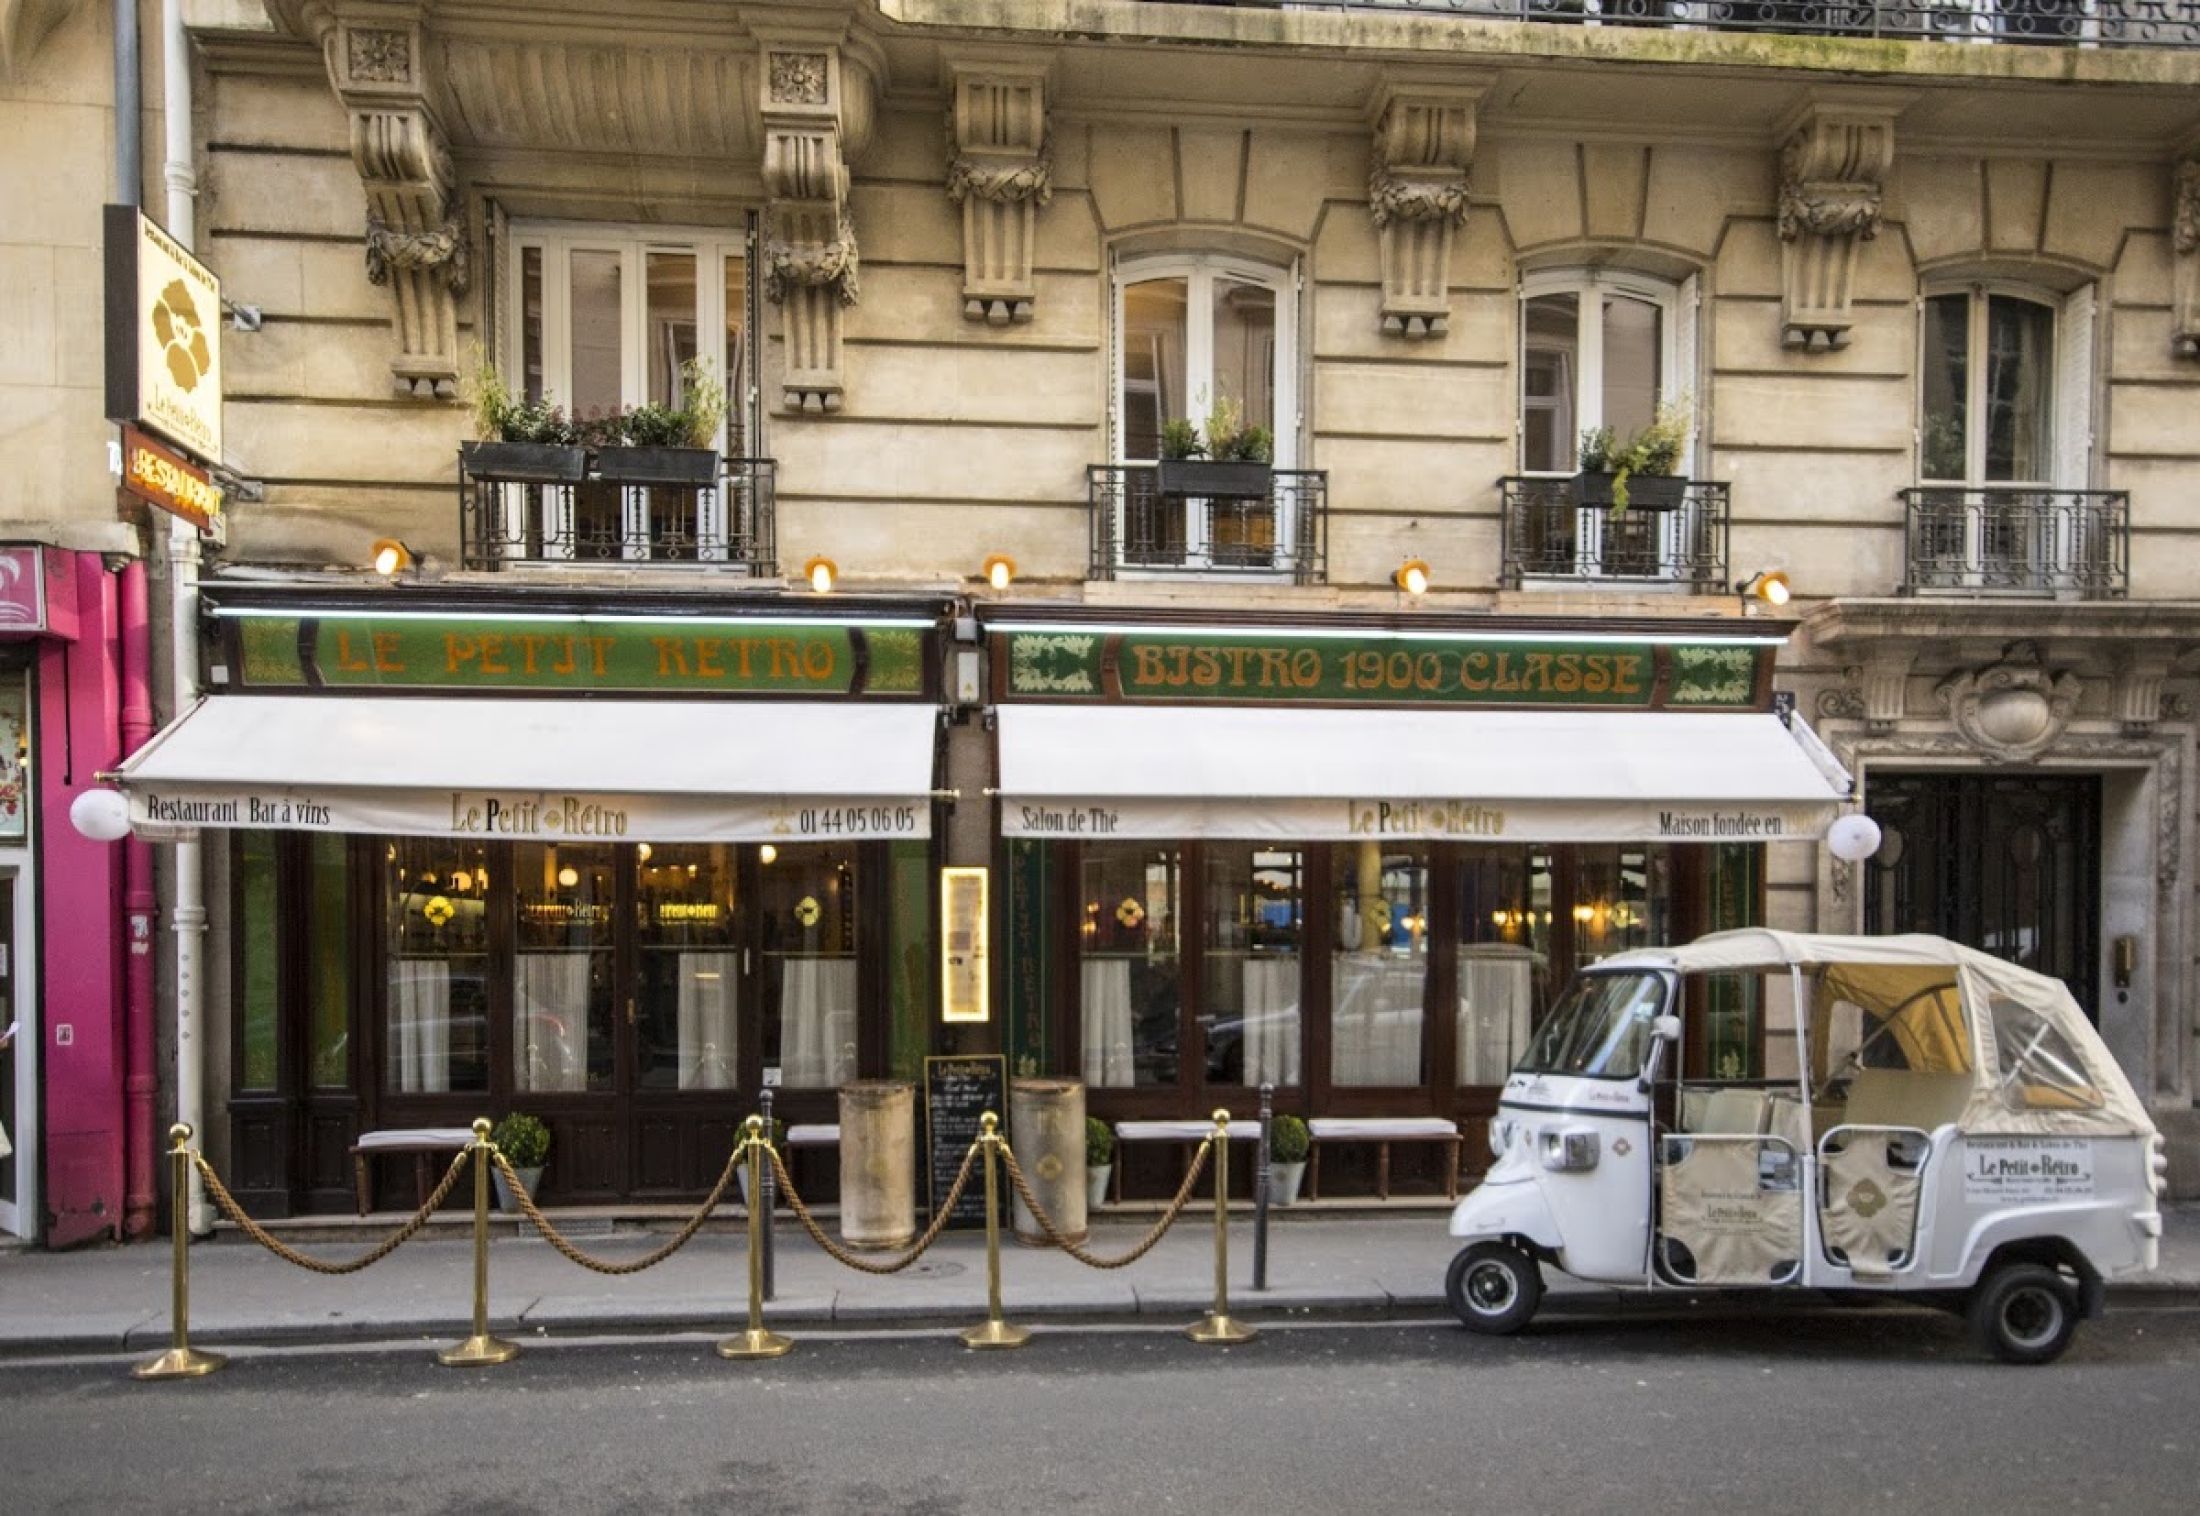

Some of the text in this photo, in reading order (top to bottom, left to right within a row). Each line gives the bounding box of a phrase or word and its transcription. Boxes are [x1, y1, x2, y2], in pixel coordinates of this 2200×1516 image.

[335, 629, 406, 673] LE
[653, 636, 835, 680] RETRO
[1338, 650, 1443, 690] 1900
[1459, 651, 1642, 693] CLASSE
[148, 794, 331, 825] Restaurant Bar à vins
[452, 792, 481, 832] Le
[485, 797, 542, 834] Petit
[800, 806, 915, 833] 01 44 05 06 05
[1022, 805, 1064, 832] Salon
[1068, 808, 1087, 833] de
[1349, 801, 1375, 833] Le
[1379, 801, 1423, 833] Petit
[1660, 811, 1710, 836] Maison
[1764, 815, 1782, 835] en
[1980, 1153, 1997, 1175] Le
[2000, 1158, 2029, 1175] Petit
